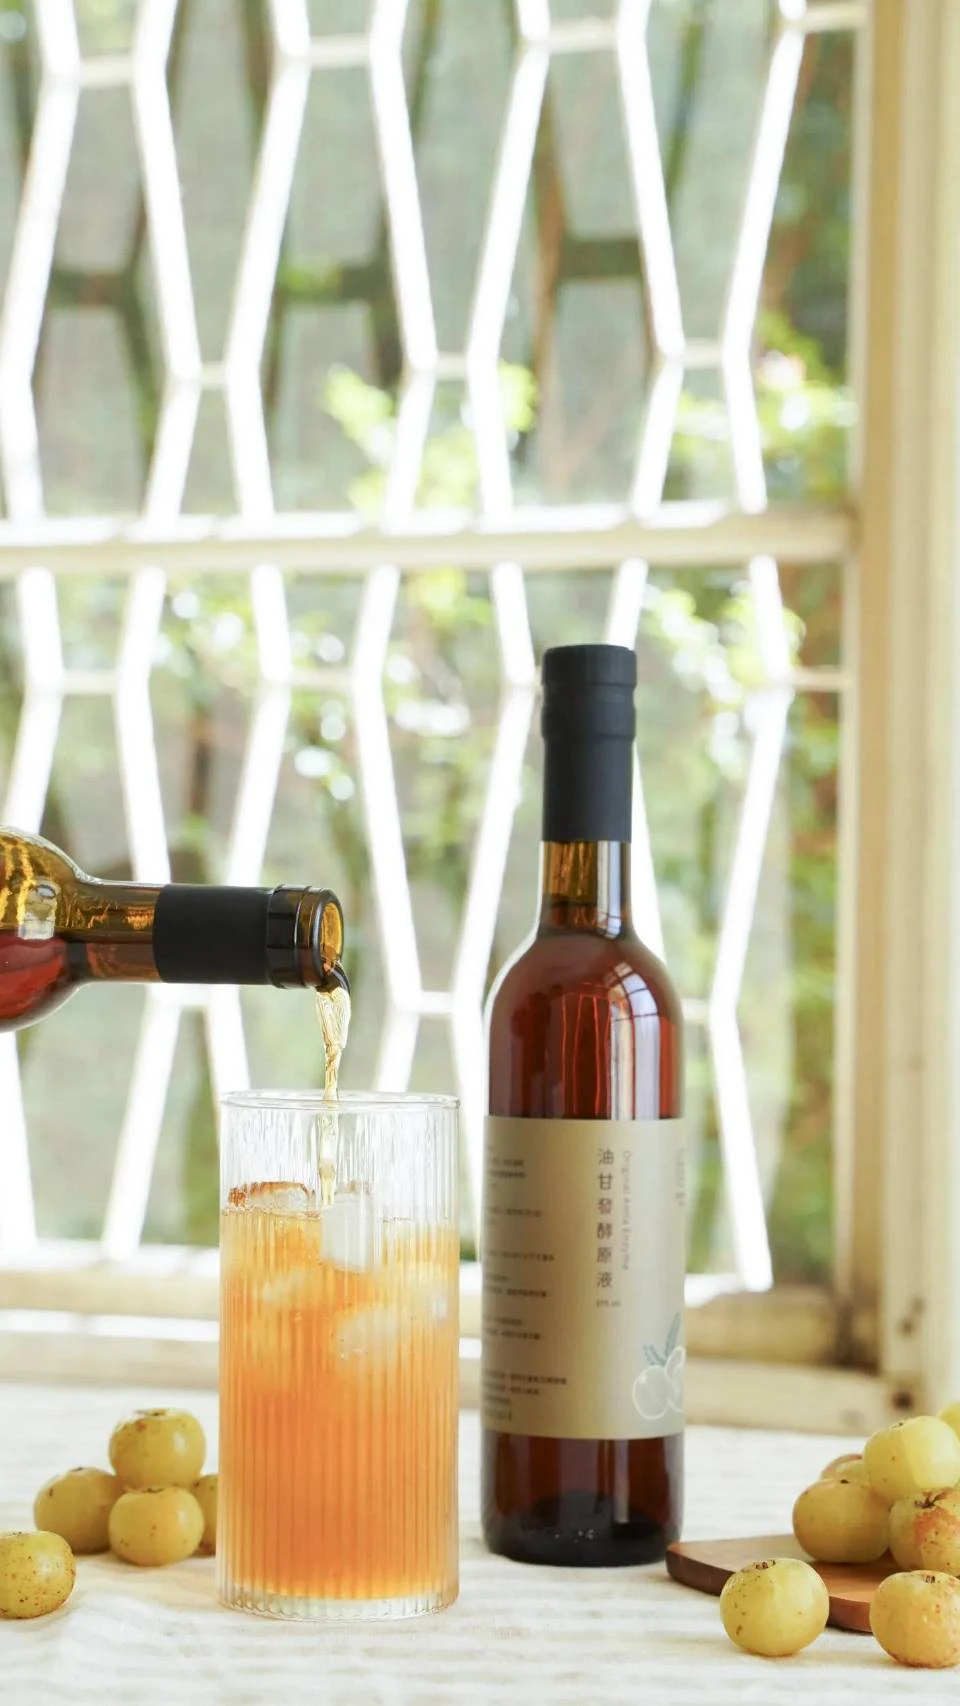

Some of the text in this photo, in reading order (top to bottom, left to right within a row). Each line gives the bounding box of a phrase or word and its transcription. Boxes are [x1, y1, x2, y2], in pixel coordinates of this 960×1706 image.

[597, 1148, 614, 1288] 油甘發酵原液
